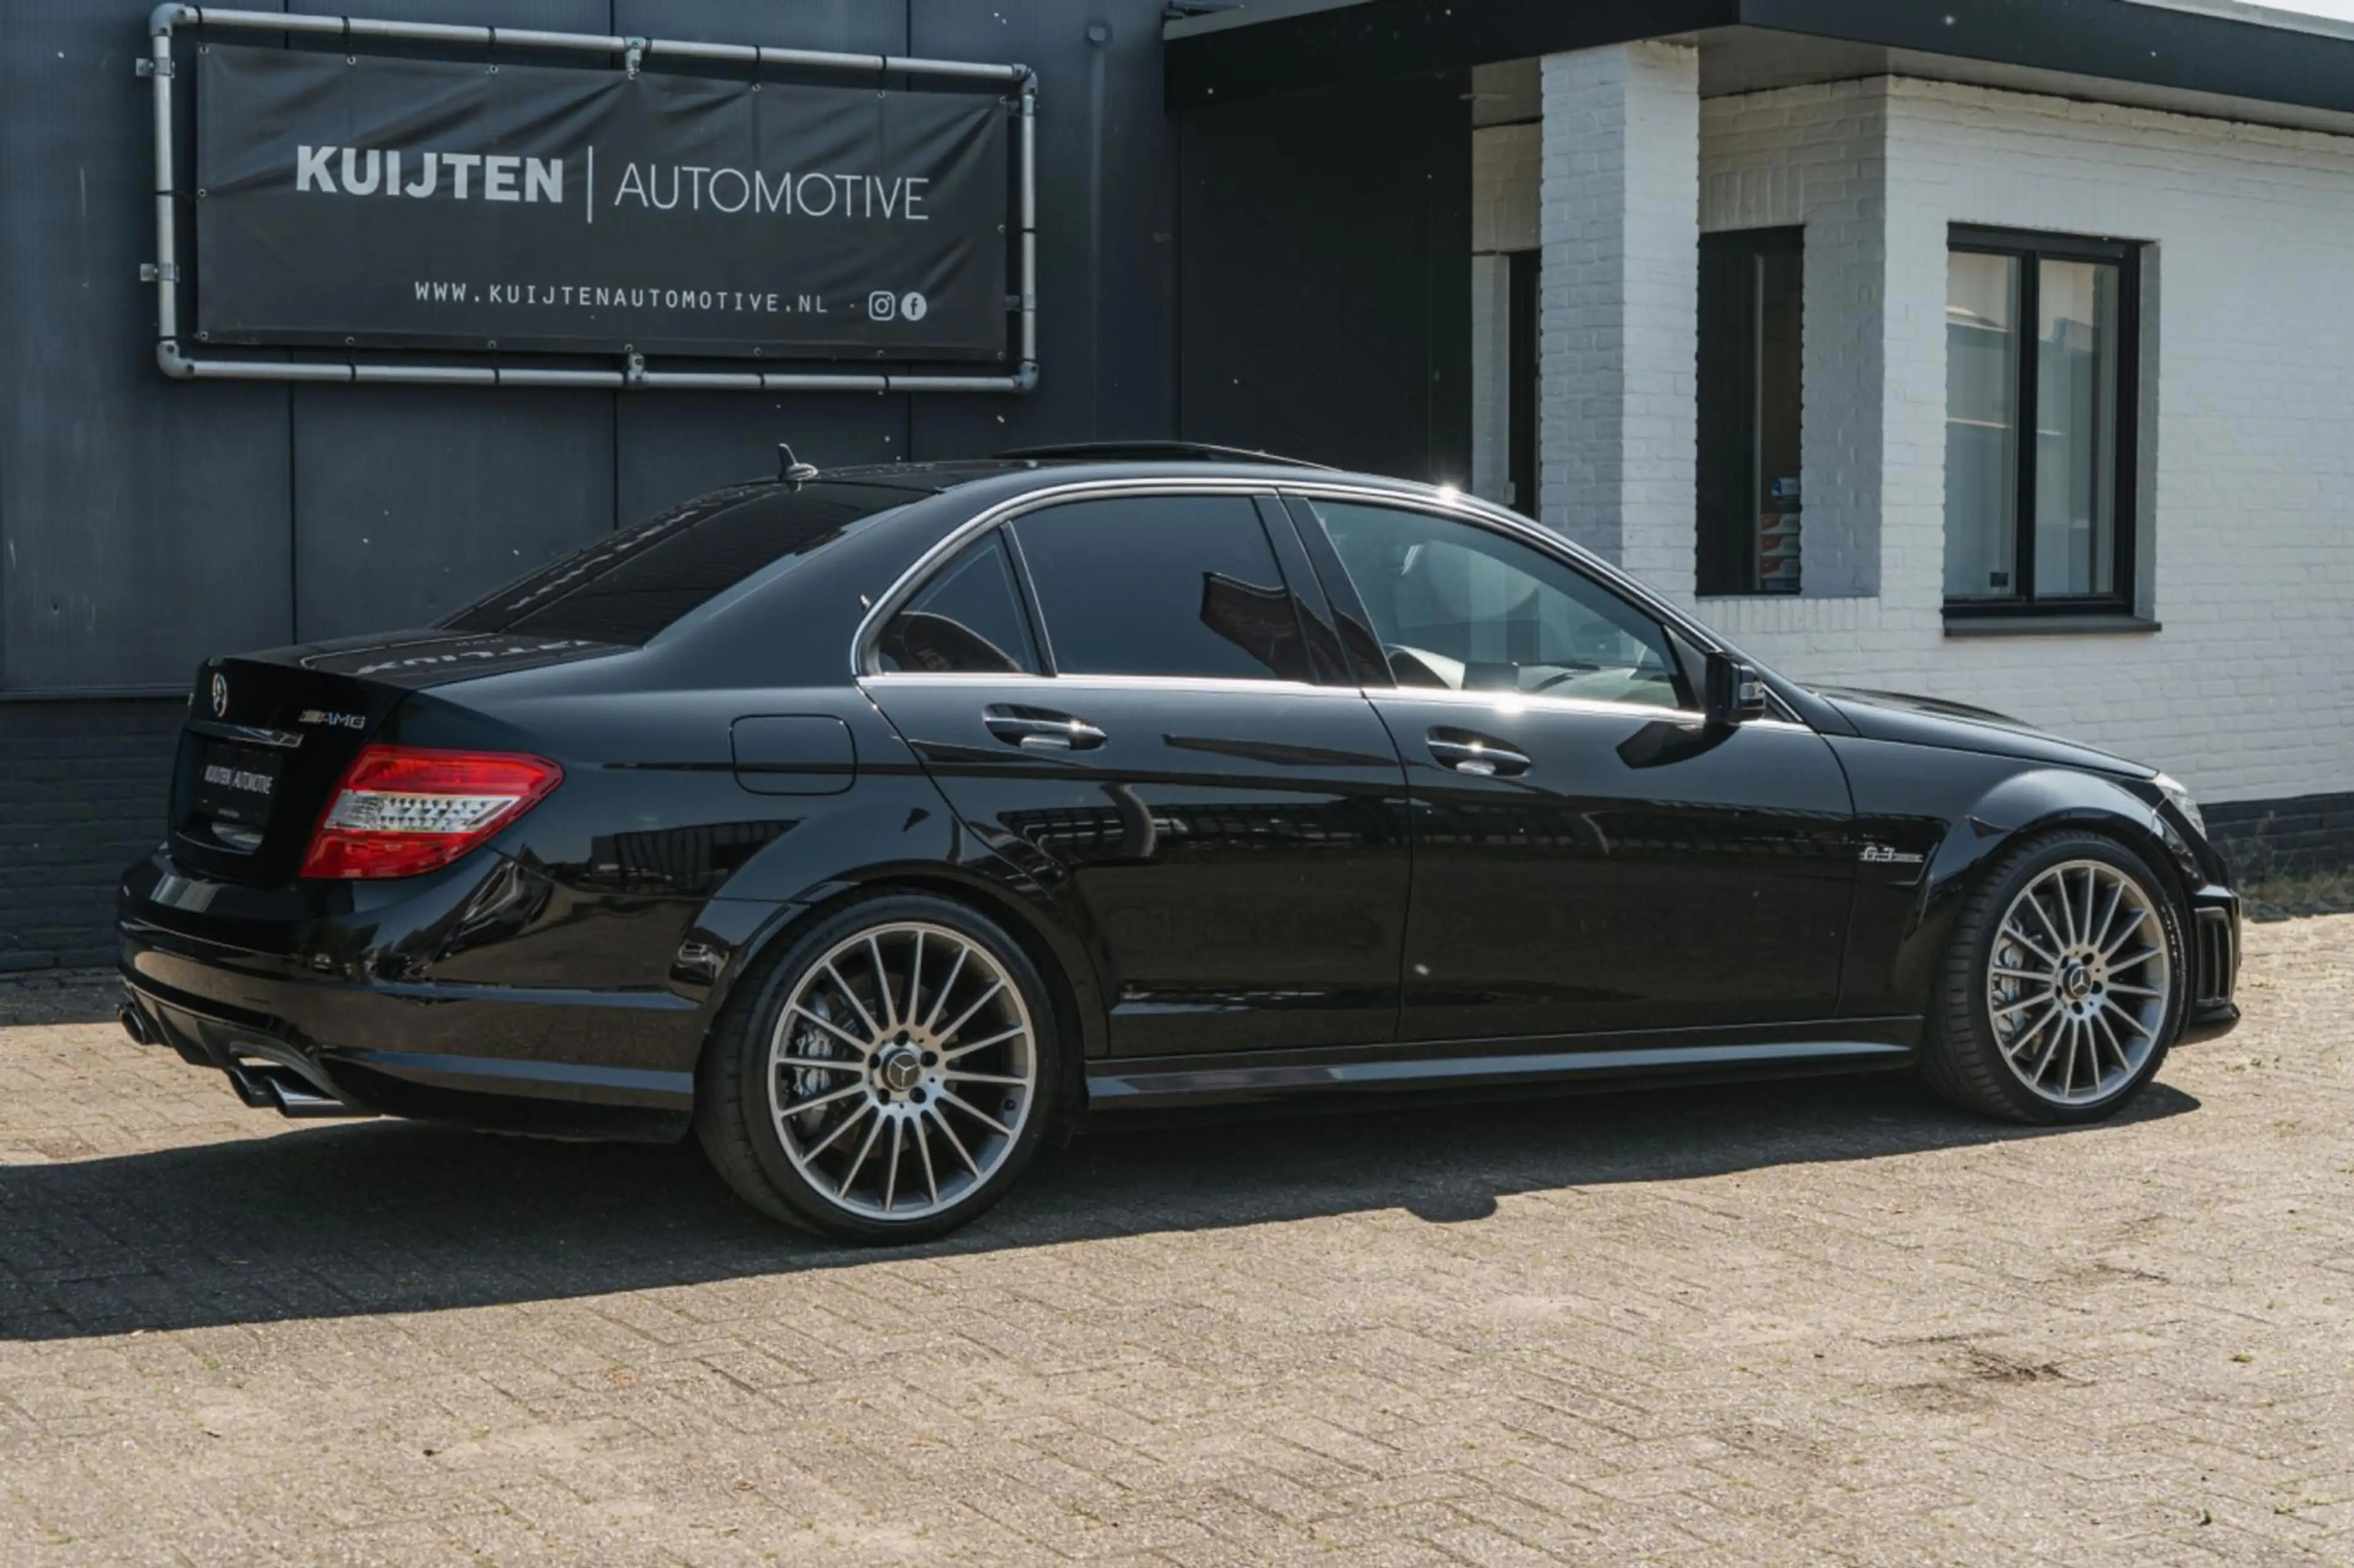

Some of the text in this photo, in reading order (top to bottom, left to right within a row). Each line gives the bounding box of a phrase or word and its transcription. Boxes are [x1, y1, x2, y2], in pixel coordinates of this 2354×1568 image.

[297, 145, 929, 221] KUIJTEN AUTOMOTIVE
[414, 281, 828, 313] WWW.KUIJTENAUTOMOTIVE.NL
[320, 710, 367, 729] AMG
